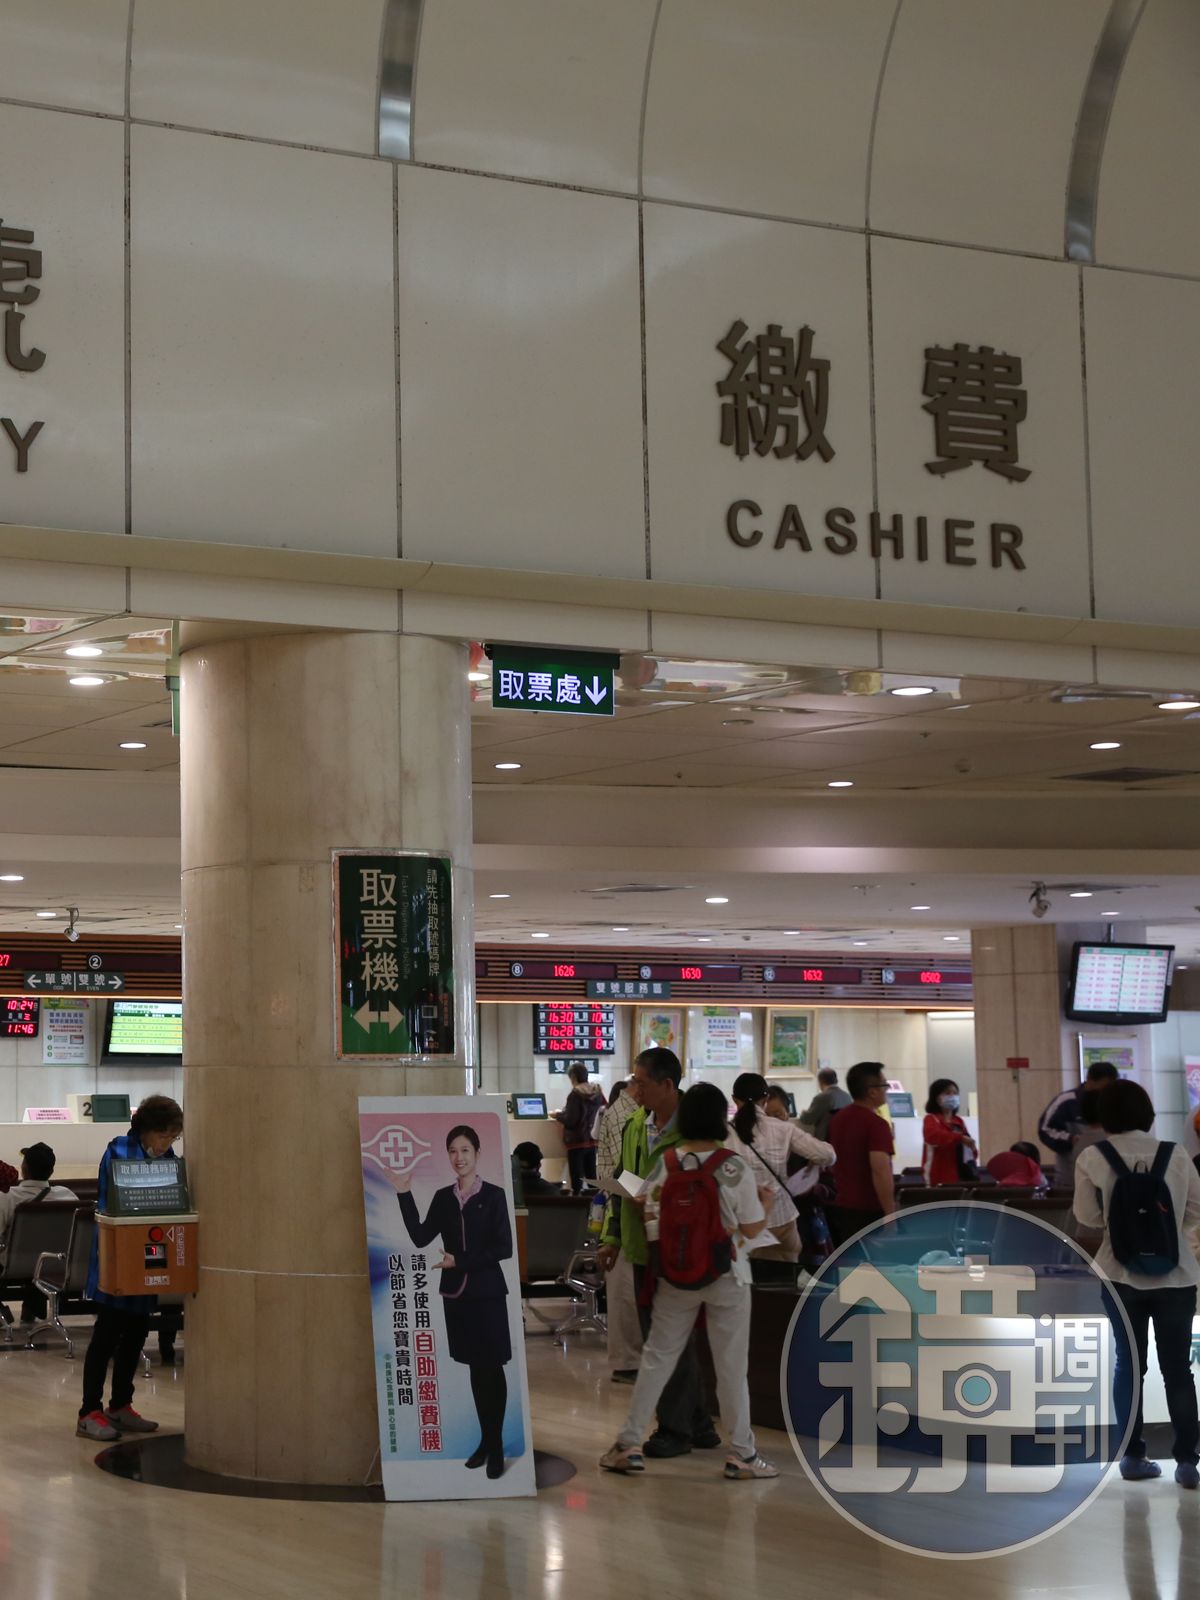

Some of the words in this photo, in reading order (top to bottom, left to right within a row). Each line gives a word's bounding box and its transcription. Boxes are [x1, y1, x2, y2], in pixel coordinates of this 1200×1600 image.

[715, 319, 1033, 483] 繳費
[726, 499, 1026, 570] CASHIER
[499, 669, 581, 704] 取票處
[359, 868, 399, 992] 取票機
[553, 964, 575, 977] 1626
[680, 967, 702, 980] 1630
[803, 969, 822, 981] 1632
[45, 973, 72, 985] 單號
[78, 974, 105, 986] 雙號
[20, 1000, 33, 1010] 24
[549, 1011, 574, 1023] 1630
[592, 1012, 602, 1023] 10
[8, 1023, 34, 1034] 11:46
[549, 1025, 574, 1037] 1628
[550, 1039, 574, 1051] 1626
[596, 1039, 602, 1050] 8
[554, 1060, 595, 1072] 雙區
[83, 1102, 92, 1116] 2
[389, 1254, 414, 1406] 以節省您寶貴時間
[411, 1254, 441, 1451] 請多使用自助繳費機
